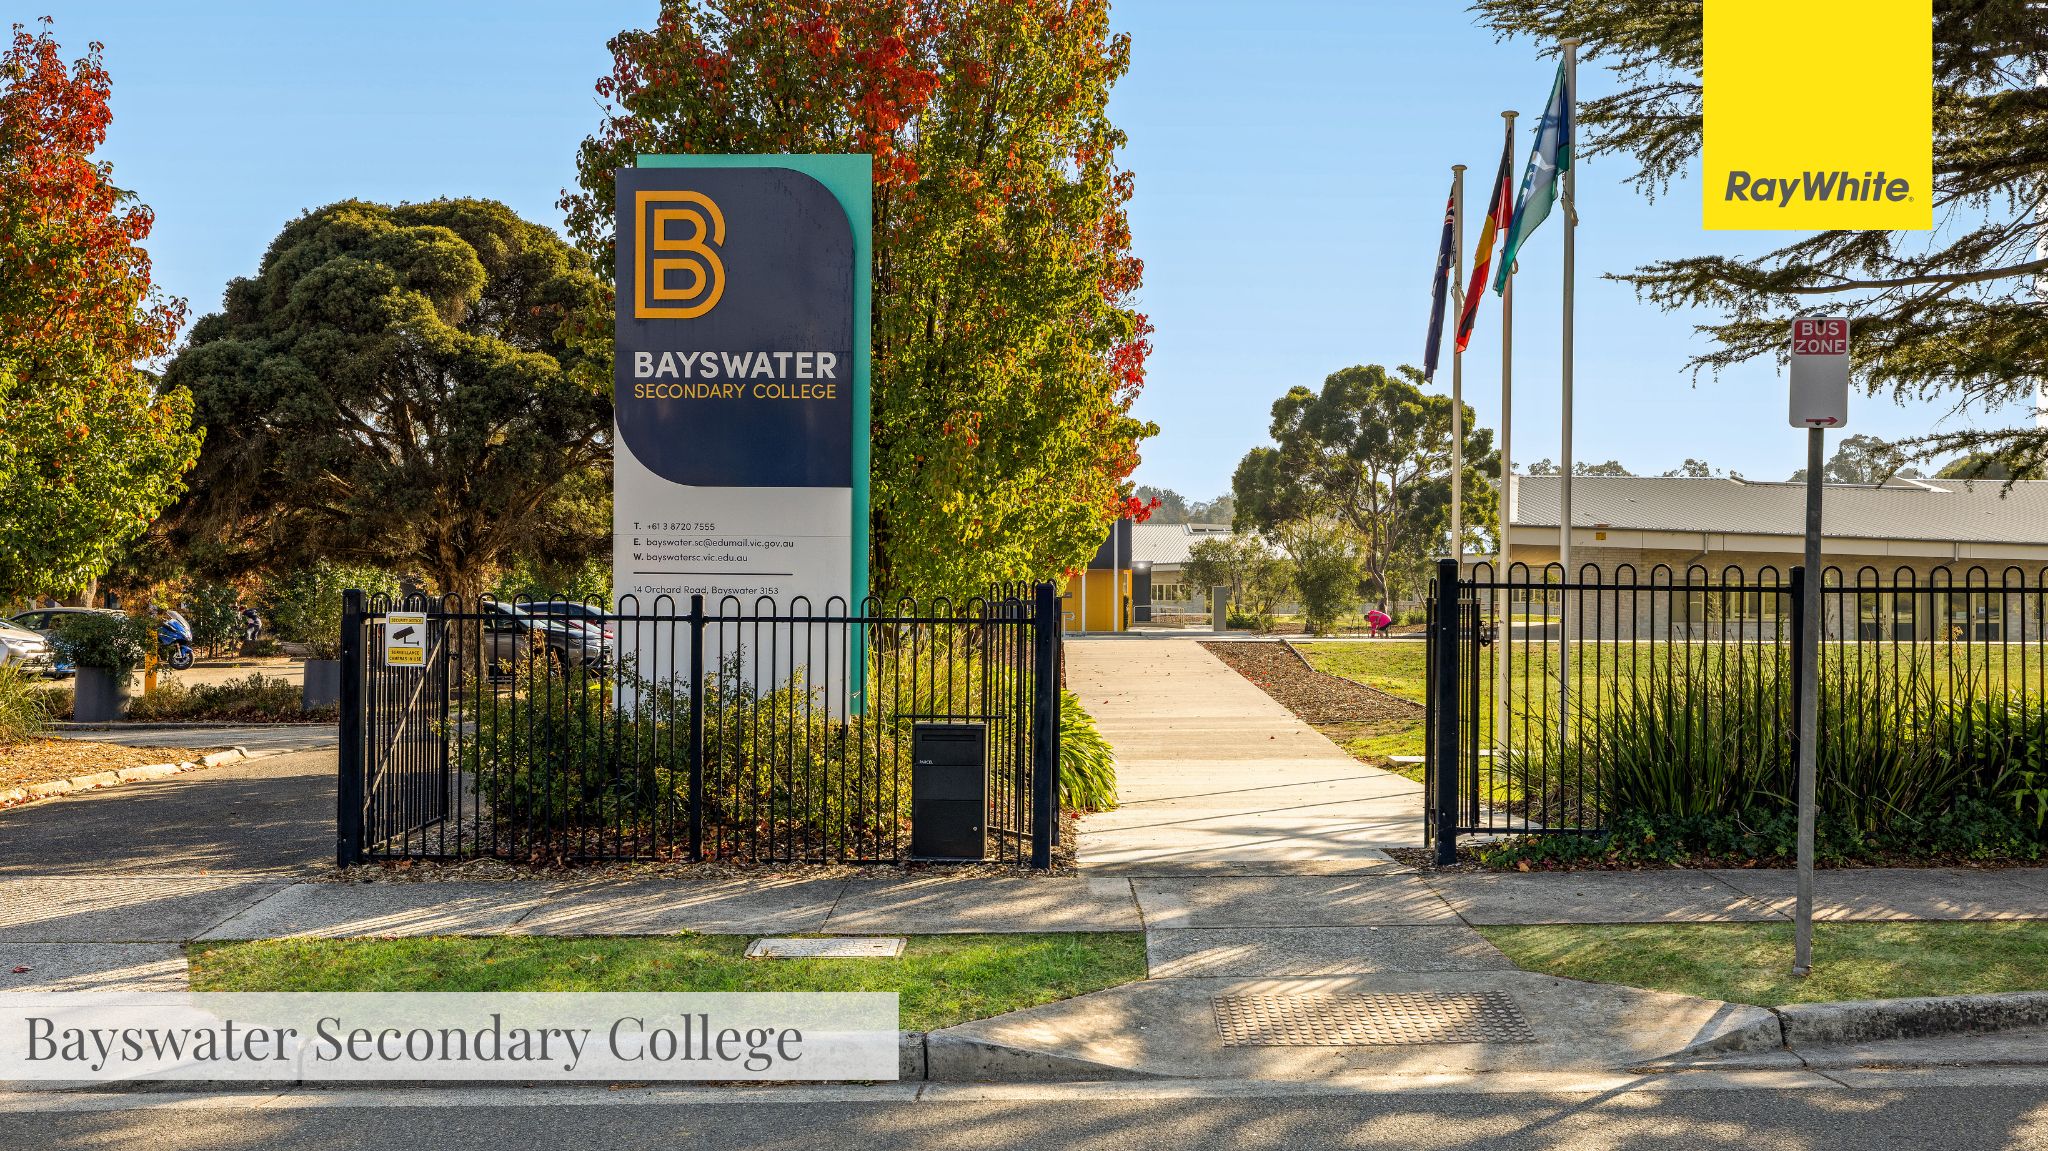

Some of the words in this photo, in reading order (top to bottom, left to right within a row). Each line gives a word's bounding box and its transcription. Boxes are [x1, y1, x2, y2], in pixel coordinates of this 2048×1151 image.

[1801, 322, 1840, 336] BUS
[1795, 339, 1846, 353] ZONE
[634, 351, 837, 379] BAYSWATER
[634, 383, 747, 400] SECONDARY
[752, 383, 837, 400] COLLEGE
[633, 522, 642, 531] T.
[647, 522, 660, 531] +61
[662, 523, 669, 531] 3
[670, 523, 692, 531] 8720
[694, 523, 716, 531] 7555
[633, 537, 642, 546] E.
[646, 538, 795, 550] bayswater.sc@edumail.vic.gov.au
[633, 552, 644, 561] W.
[646, 553, 748, 563] bayswatersc.vic.edu.au
[633, 586, 642, 594] 14
[644, 585, 682, 595] Orchard
[684, 586, 709, 596] Road,
[711, 586, 758, 597] Bayswater
[760, 586, 779, 595] 3153
